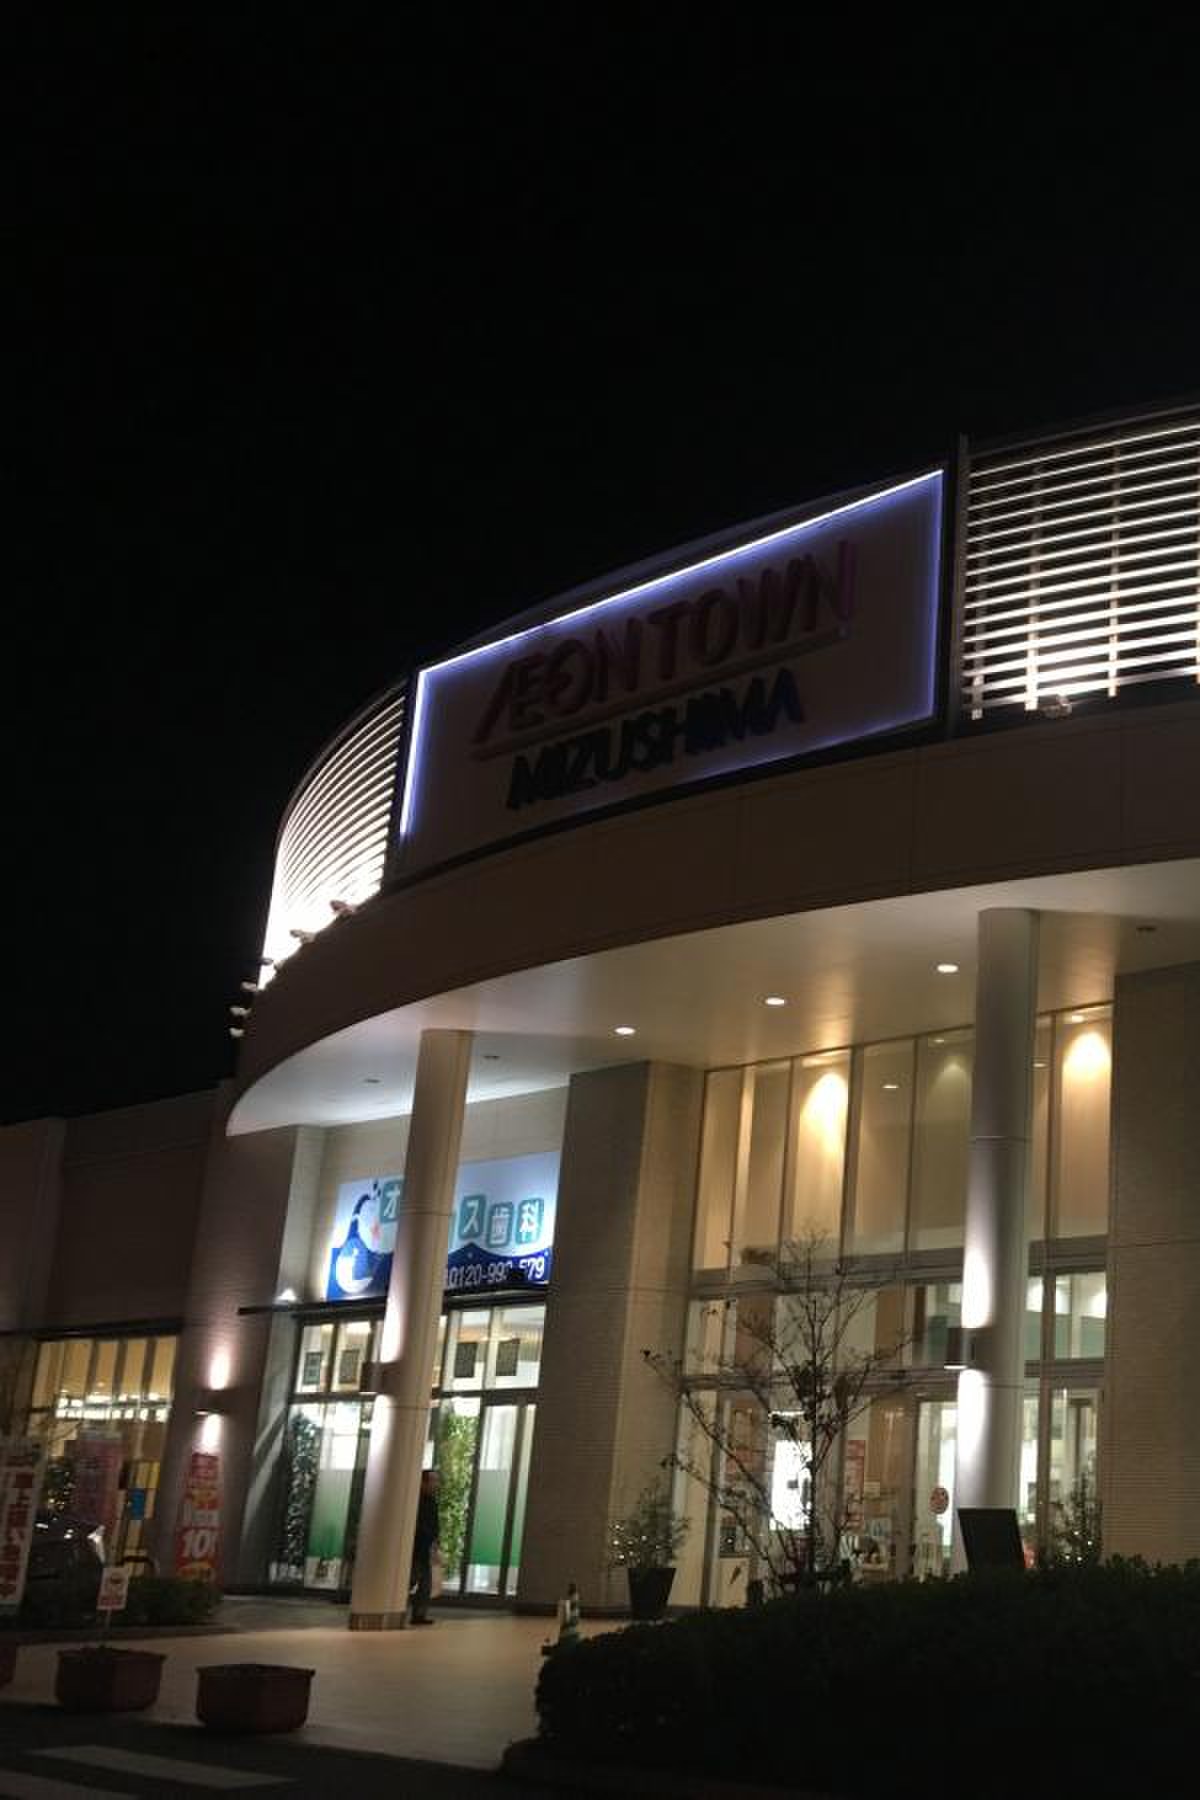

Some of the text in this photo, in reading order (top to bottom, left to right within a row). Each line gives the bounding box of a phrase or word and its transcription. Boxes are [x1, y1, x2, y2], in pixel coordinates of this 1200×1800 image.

[506, 667, 806, 811] MIZUSHIMA
[381, 1184, 542, 1248] オス歯科
